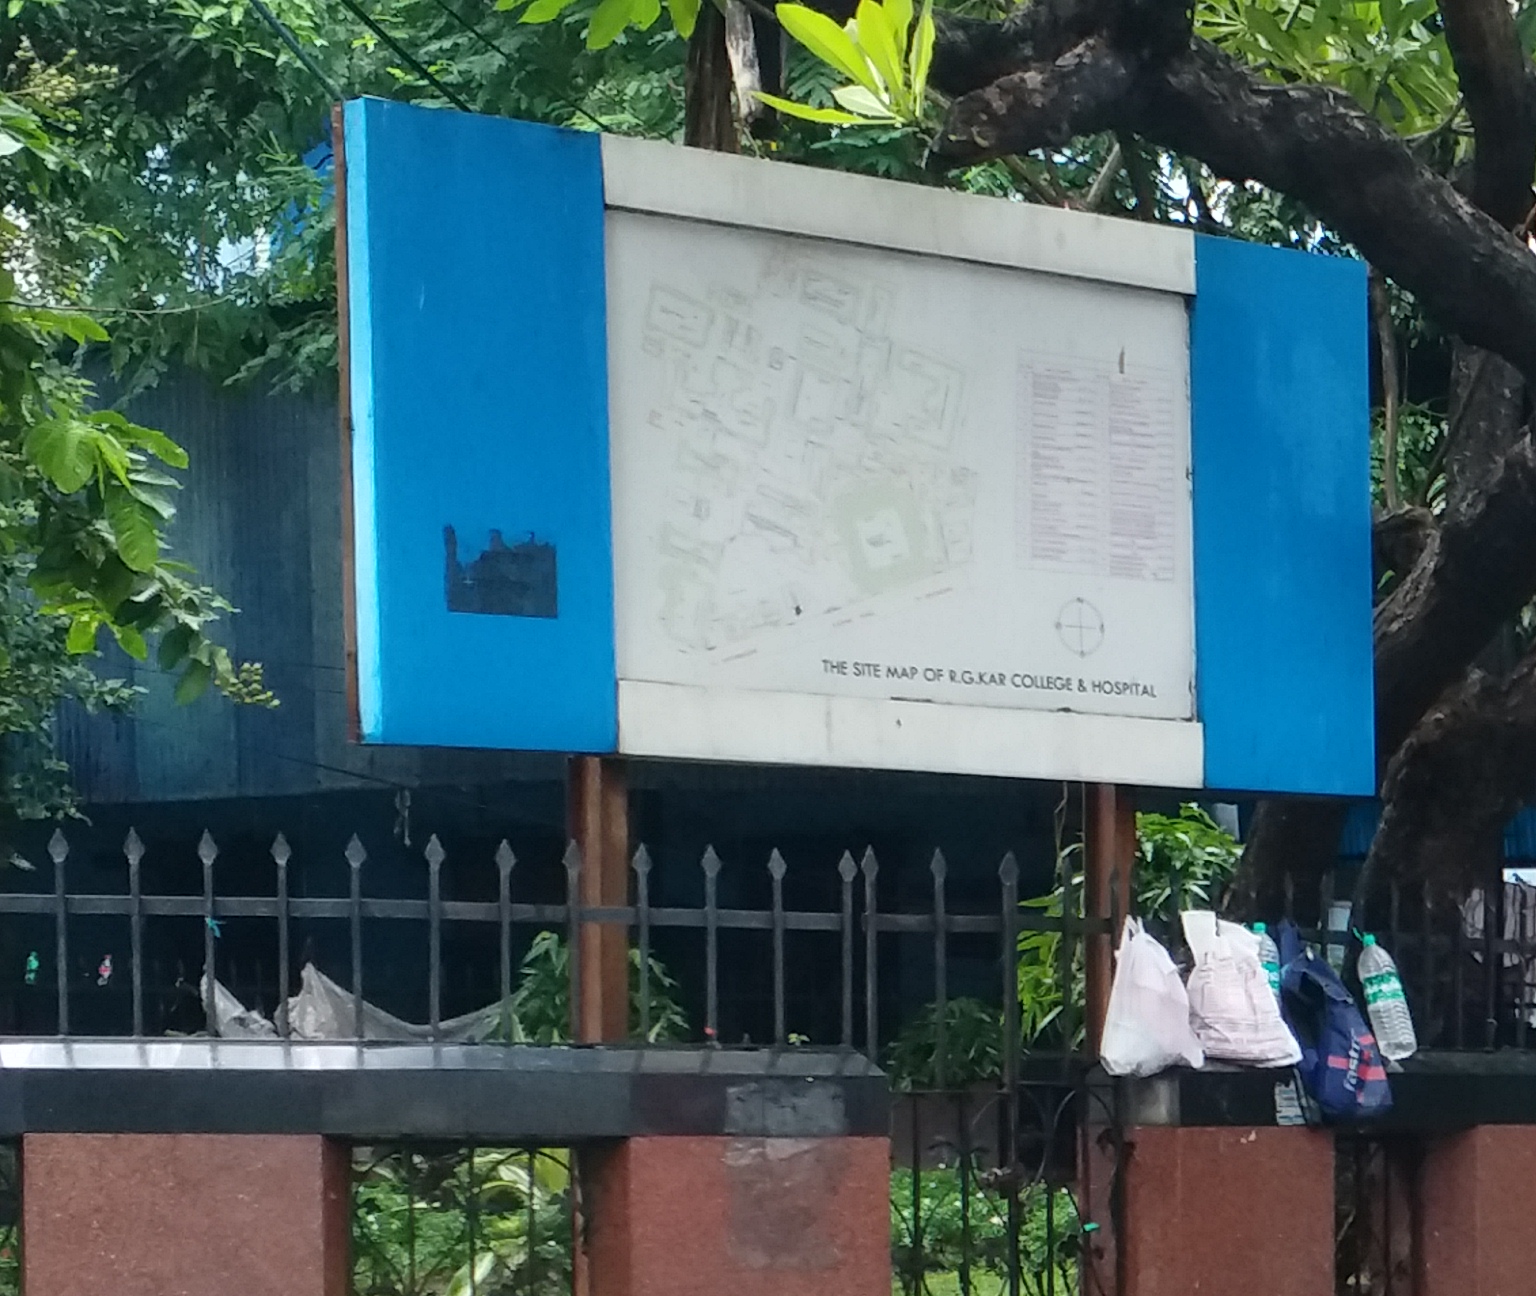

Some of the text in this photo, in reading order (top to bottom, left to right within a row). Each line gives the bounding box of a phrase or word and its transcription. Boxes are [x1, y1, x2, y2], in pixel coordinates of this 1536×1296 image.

[822, 659, 1158, 698] THE SITE MAP OF R.G.KAR COLLEGE & HOSPITAL
